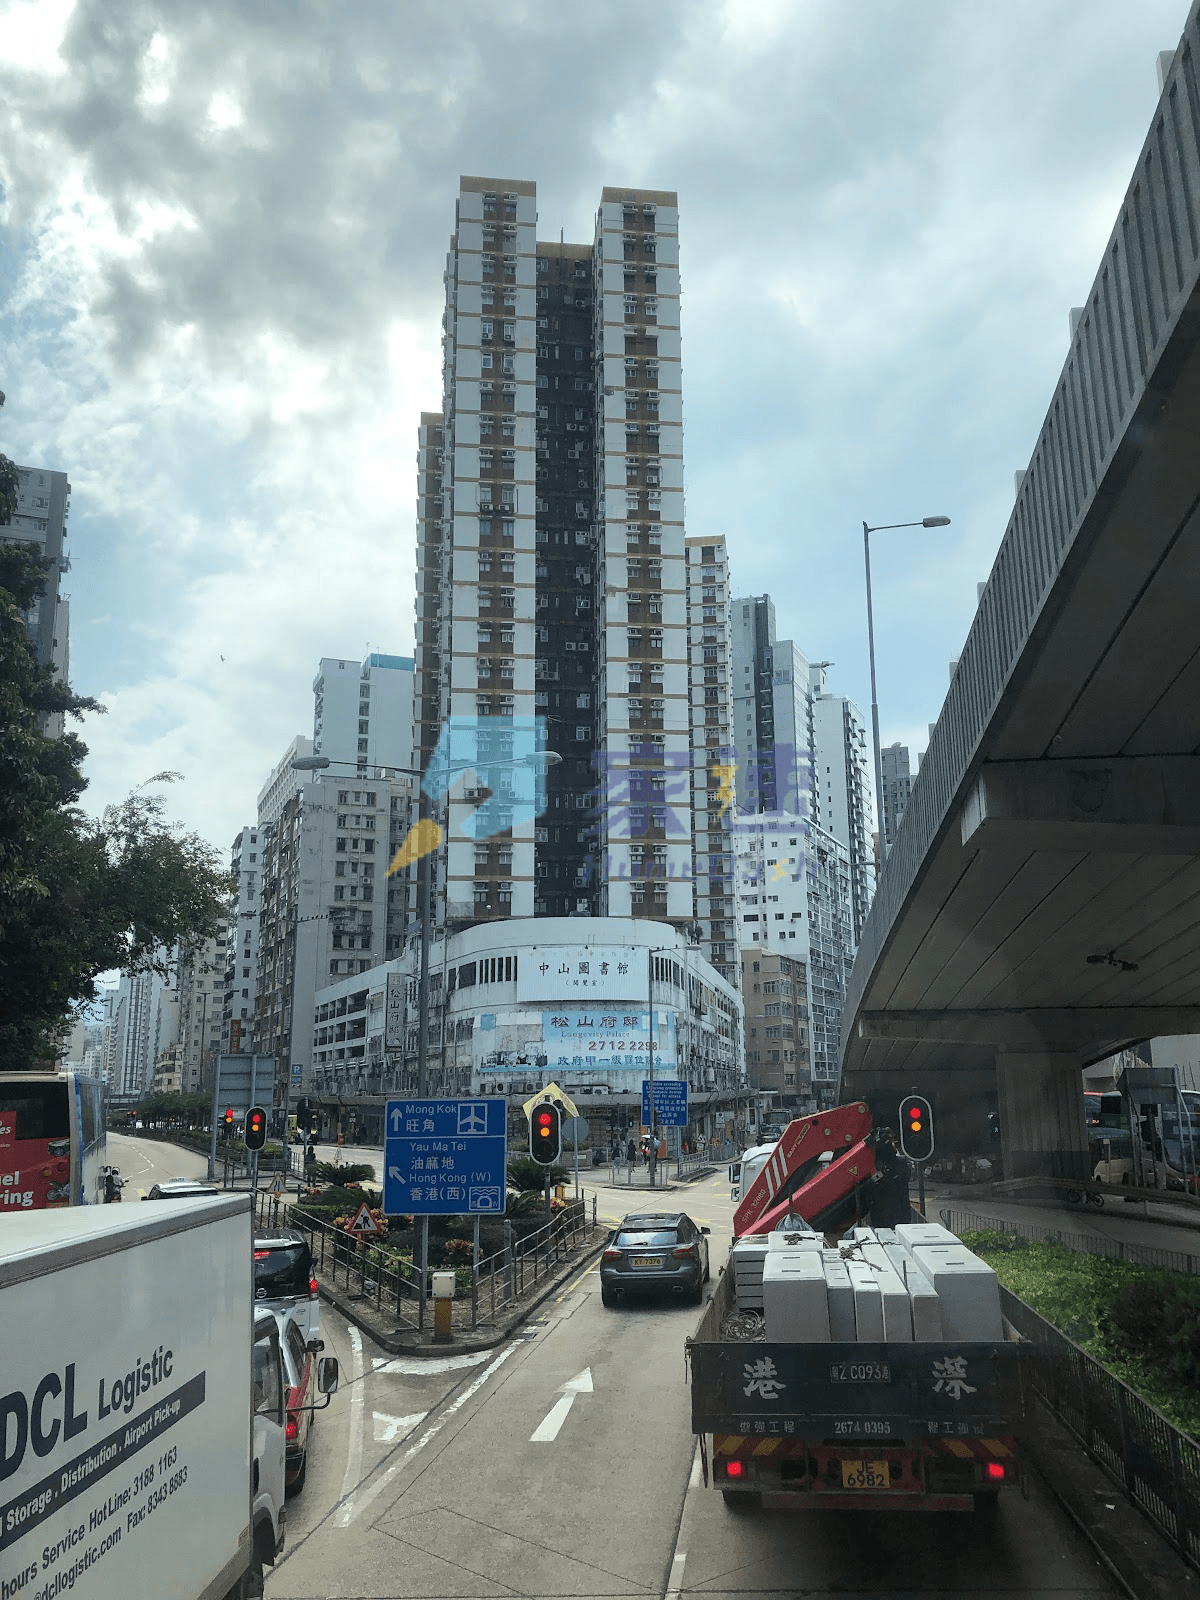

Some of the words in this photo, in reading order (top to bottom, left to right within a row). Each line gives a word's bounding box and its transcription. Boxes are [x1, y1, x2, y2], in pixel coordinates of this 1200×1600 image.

[538, 961, 629, 977] 中山圖書館
[550, 1015, 640, 1029] 松山府邸
[561, 1031, 604, 1039] Longevity
[606, 1030, 631, 1038] Palace
[588, 1040, 626, 1051] 2712
[629, 1040, 658, 1051] 2298
[405, 1104, 435, 1115] Mong
[436, 1104, 457, 1114] Kok
[405, 1118, 435, 1133] 旺角
[409, 1142, 429, 1152] Yau
[432, 1142, 449, 1151] Ma
[450, 1141, 467, 1151] Tei
[410, 1156, 455, 1170] 油麻地
[409, 1173, 437, 1184] Hong
[439, 1173, 467, 1184] Kong
[470, 1171, 492, 1183] (W)
[409, 1186, 466, 1201] 香港(西)
[742, 1355, 787, 1400] 港
[931, 1355, 978, 1401] 深
[0, 1362, 88, 1483] DCL
[98, 1345, 174, 1421] Logistic
[834, 1421, 860, 1434] 2674
[864, 1421, 891, 1434] 0395
[6, 1488, 52, 1531] Storage
[61, 1443, 117, 1493] Distribution
[123, 1416, 153, 1449] Airport
[154, 1399, 181, 1427] Pick-up
[856, 1460, 875, 1474] JE
[847, 1473, 885, 1487] 6982
[147, 1482, 168, 1514] 8343
[1, 1561, 38, 1600] hours
[42, 1524, 85, 1570] Service
[133, 1464, 154, 1496] 3188
[158, 1445, 177, 1475] 1163
